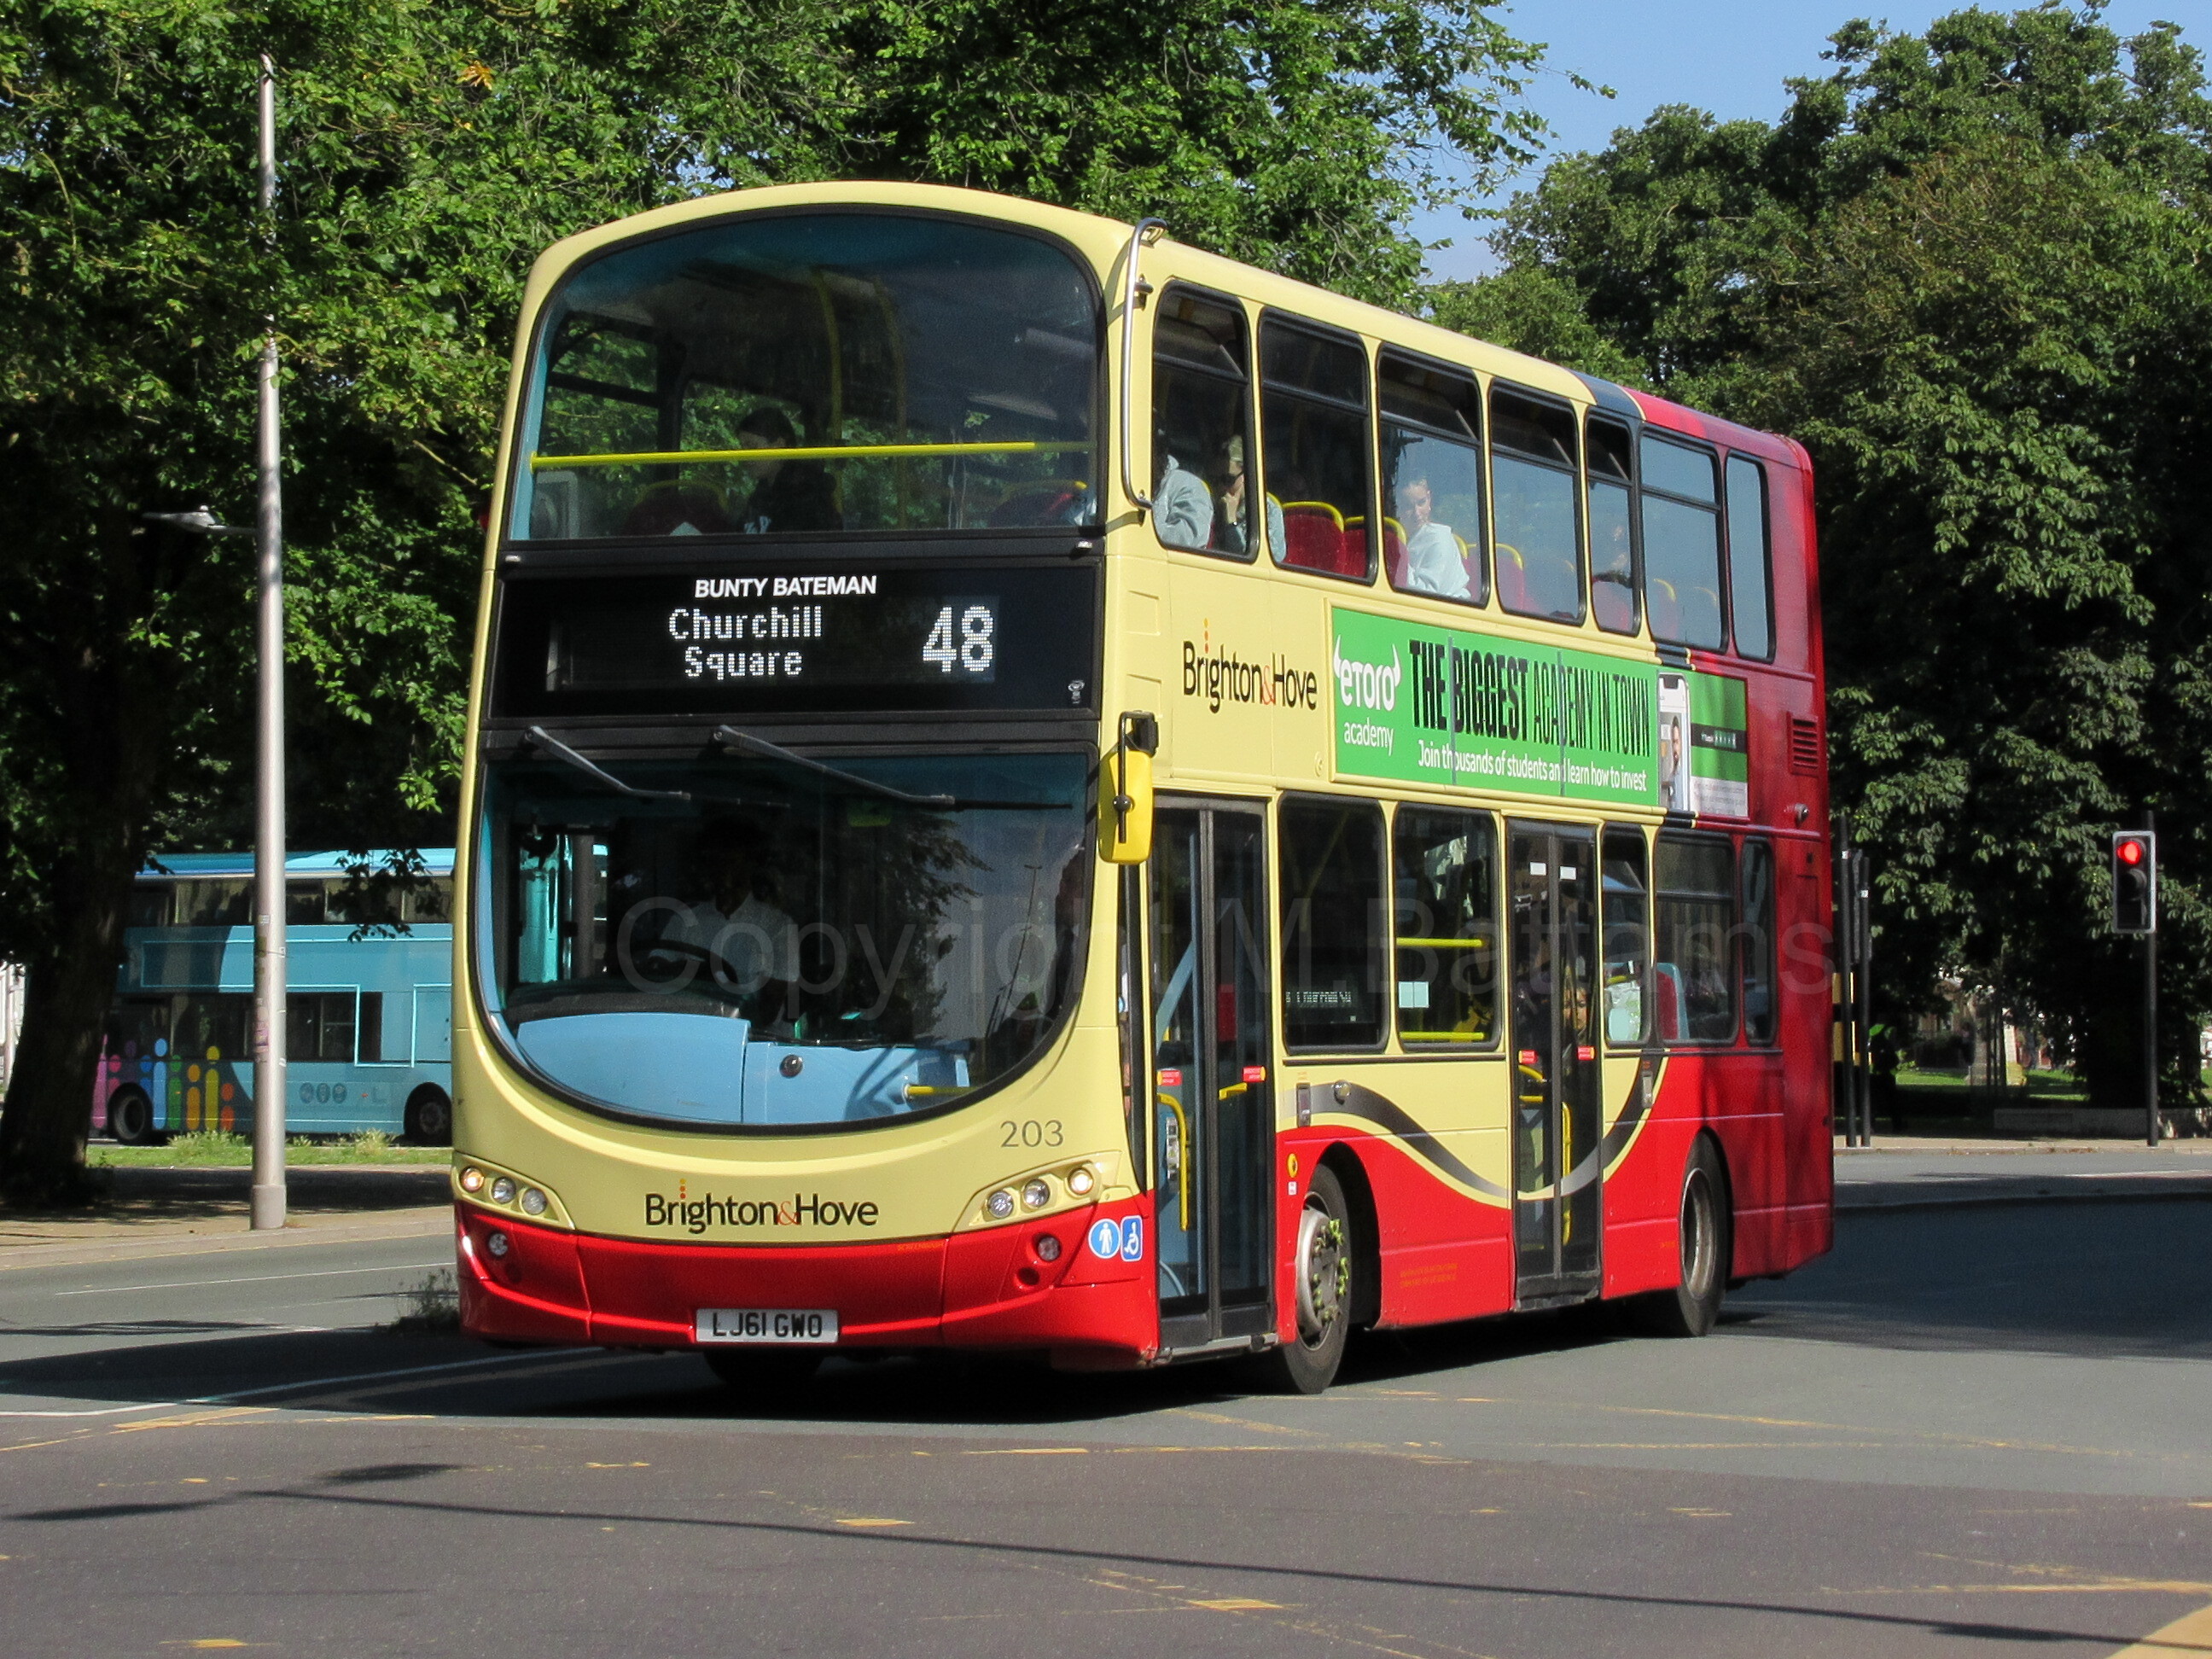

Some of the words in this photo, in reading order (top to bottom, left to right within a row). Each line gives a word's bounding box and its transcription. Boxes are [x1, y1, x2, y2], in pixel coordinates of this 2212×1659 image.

[694, 578, 768, 598] BUNTY
[773, 575, 877, 597] BATEMAN
[668, 605, 823, 640] Churchill
[922, 605, 995, 673] 48
[684, 646, 803, 681] Square
[1409, 639, 1447, 731] THE
[1452, 646, 1528, 742] BIGGEST
[1534, 661, 1593, 750] ACADEMY
[1597, 671, 1611, 753] IN
[1613, 673, 1650, 758] TOWN
[1343, 716, 1394, 757] academy
[1417, 739, 1440, 768] Join
[1442, 743, 1493, 775] thousands
[1495, 749, 1506, 776] of
[1507, 754, 1547, 781] students
[1568, 758, 1589, 785] learn
[1591, 761, 1609, 787] how
[1610, 766, 1620, 789] to
[1621, 765, 1647, 792] invest
[999, 1120, 1065, 1147] 203
[712, 1312, 766, 1336] LJ61
[774, 1313, 822, 1337] GWO
